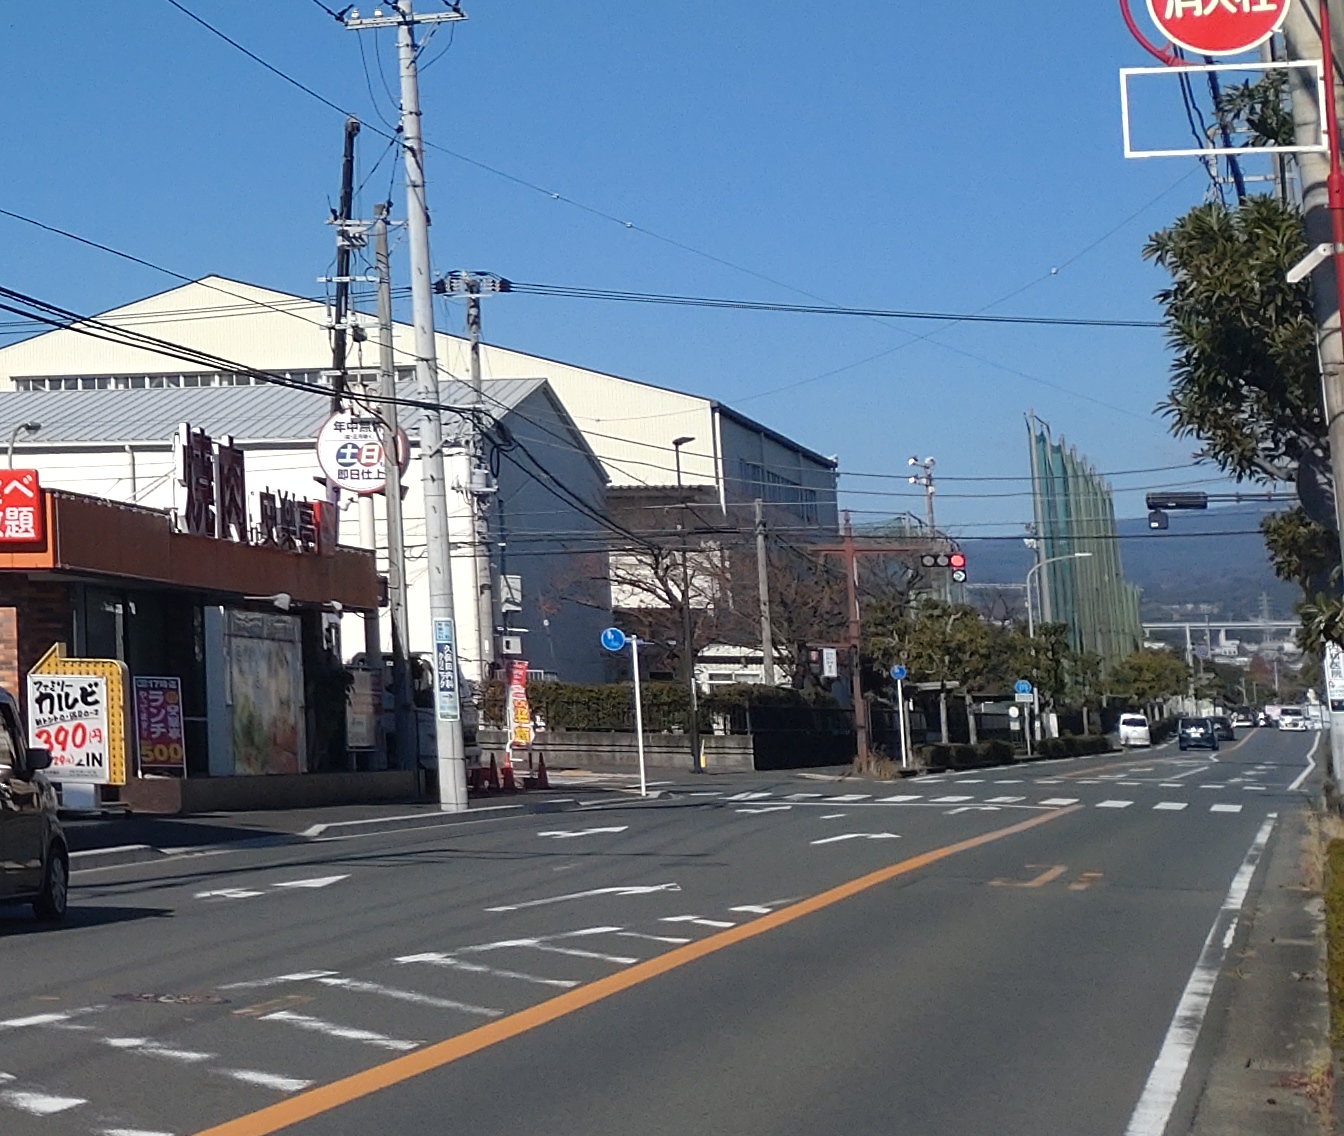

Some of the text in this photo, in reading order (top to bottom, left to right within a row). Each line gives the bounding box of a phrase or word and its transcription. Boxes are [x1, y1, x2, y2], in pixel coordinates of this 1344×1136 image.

[34, 681, 101, 715] カルビ
[148, 690, 167, 739] ランチ
[140, 739, 184, 762] 500
